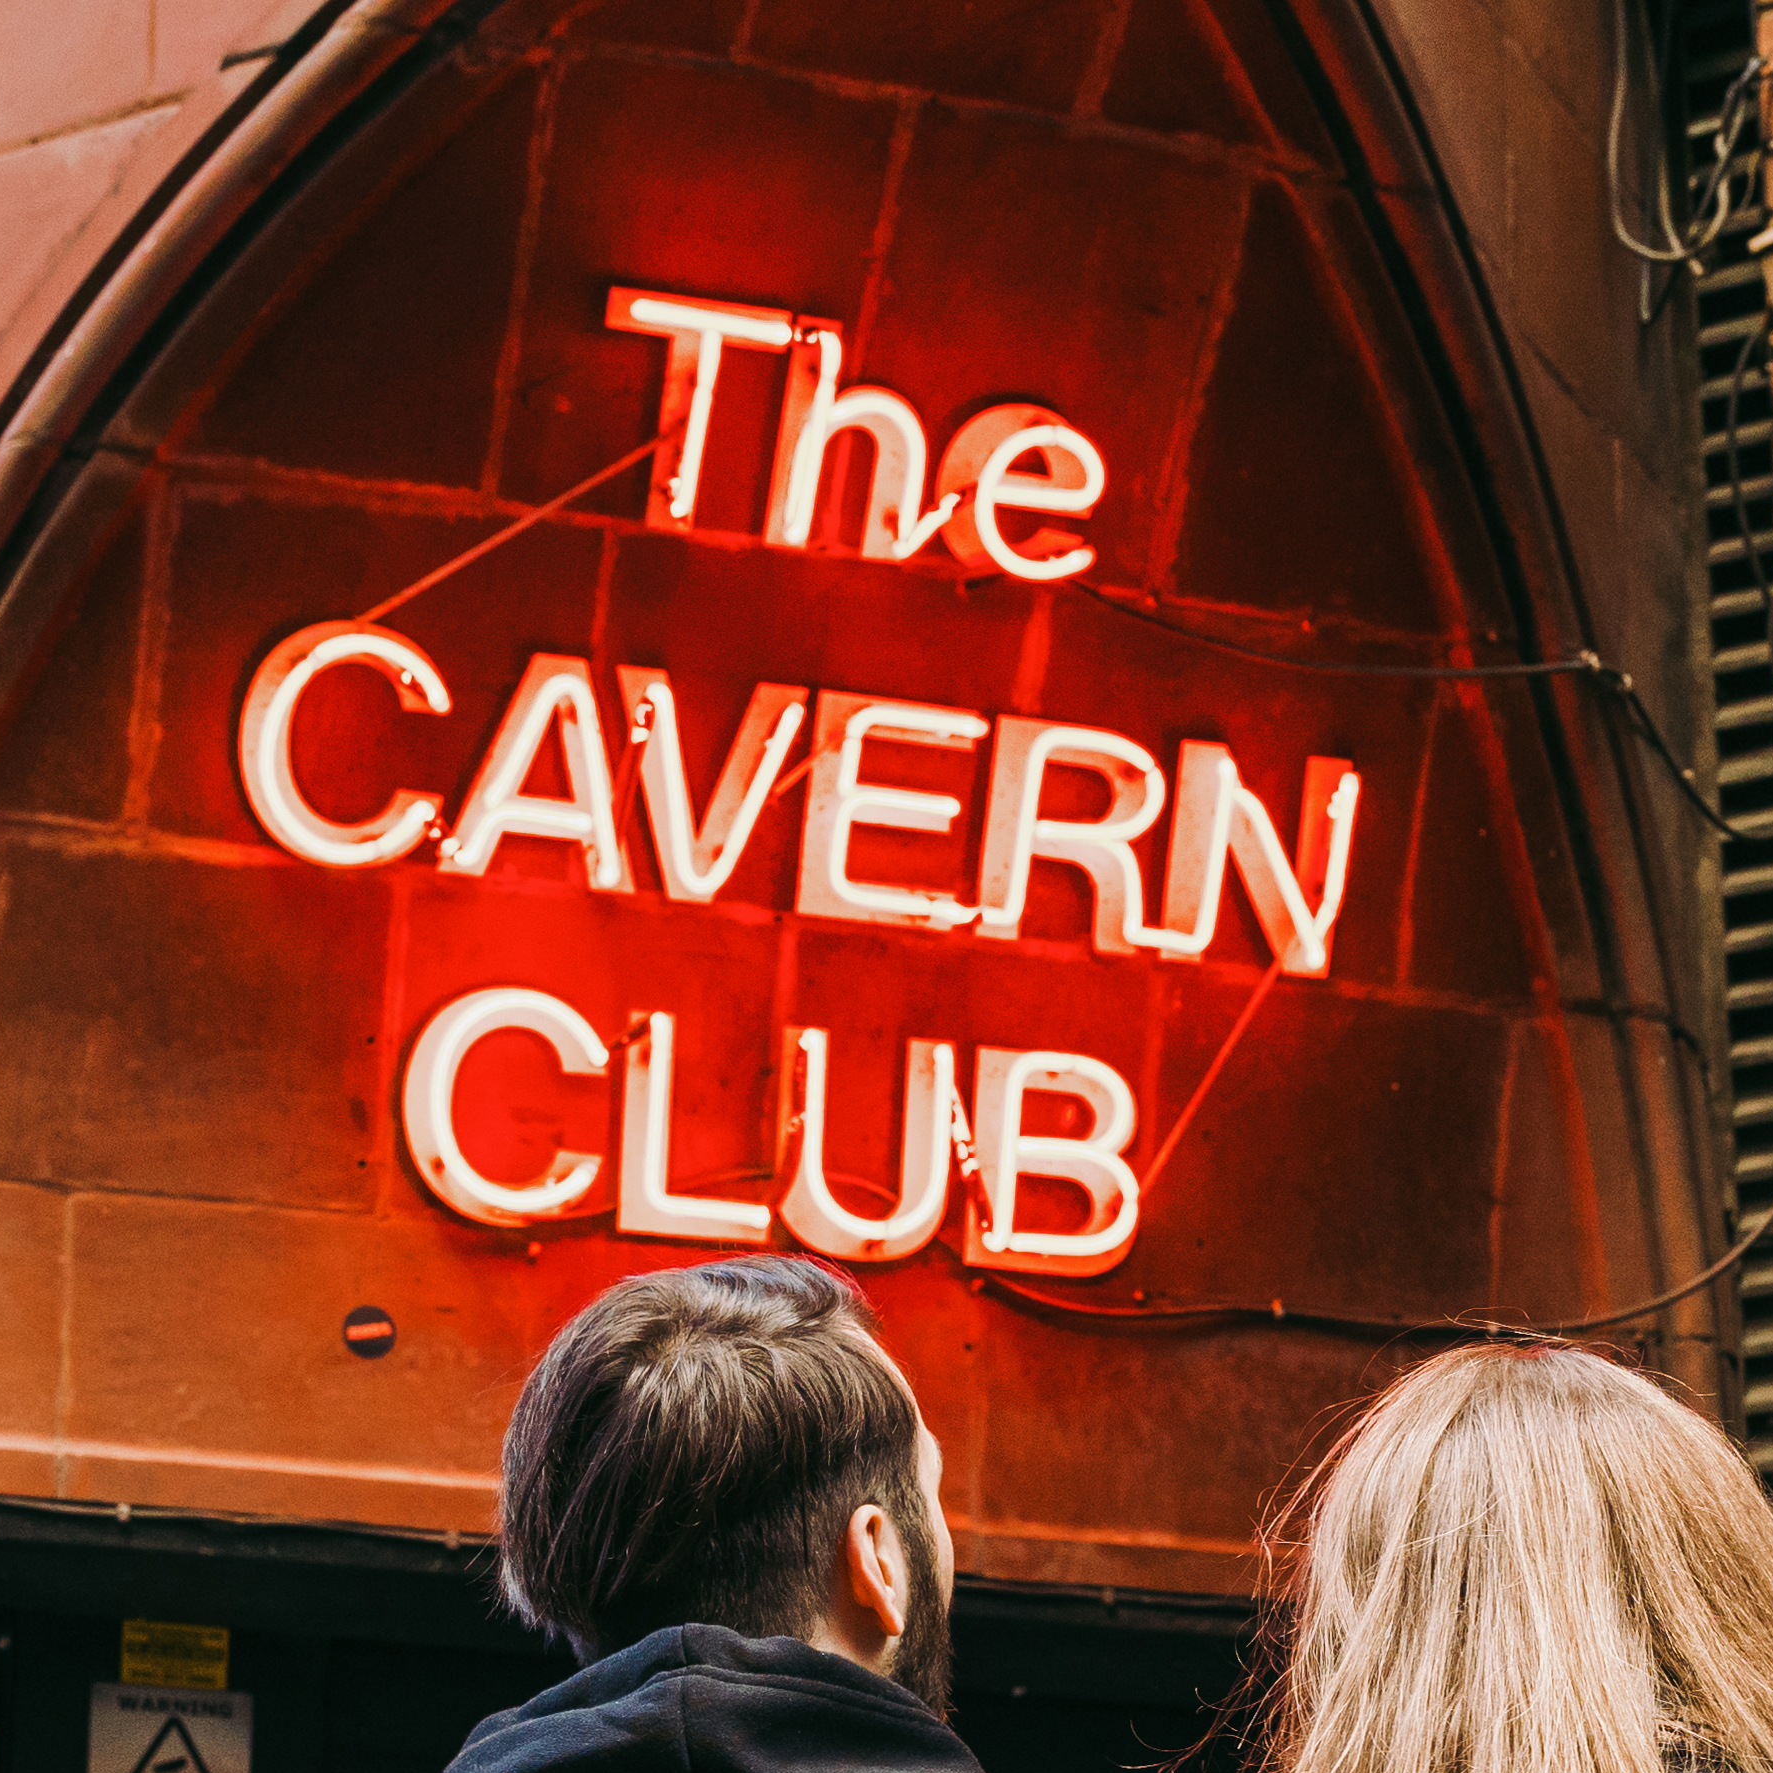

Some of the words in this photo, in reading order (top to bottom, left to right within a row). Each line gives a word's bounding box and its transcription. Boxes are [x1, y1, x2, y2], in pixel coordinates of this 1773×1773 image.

[607, 286, 1106, 580] The
[239, 620, 1359, 977] CAVERN
[403, 988, 1140, 1276] CLUB
